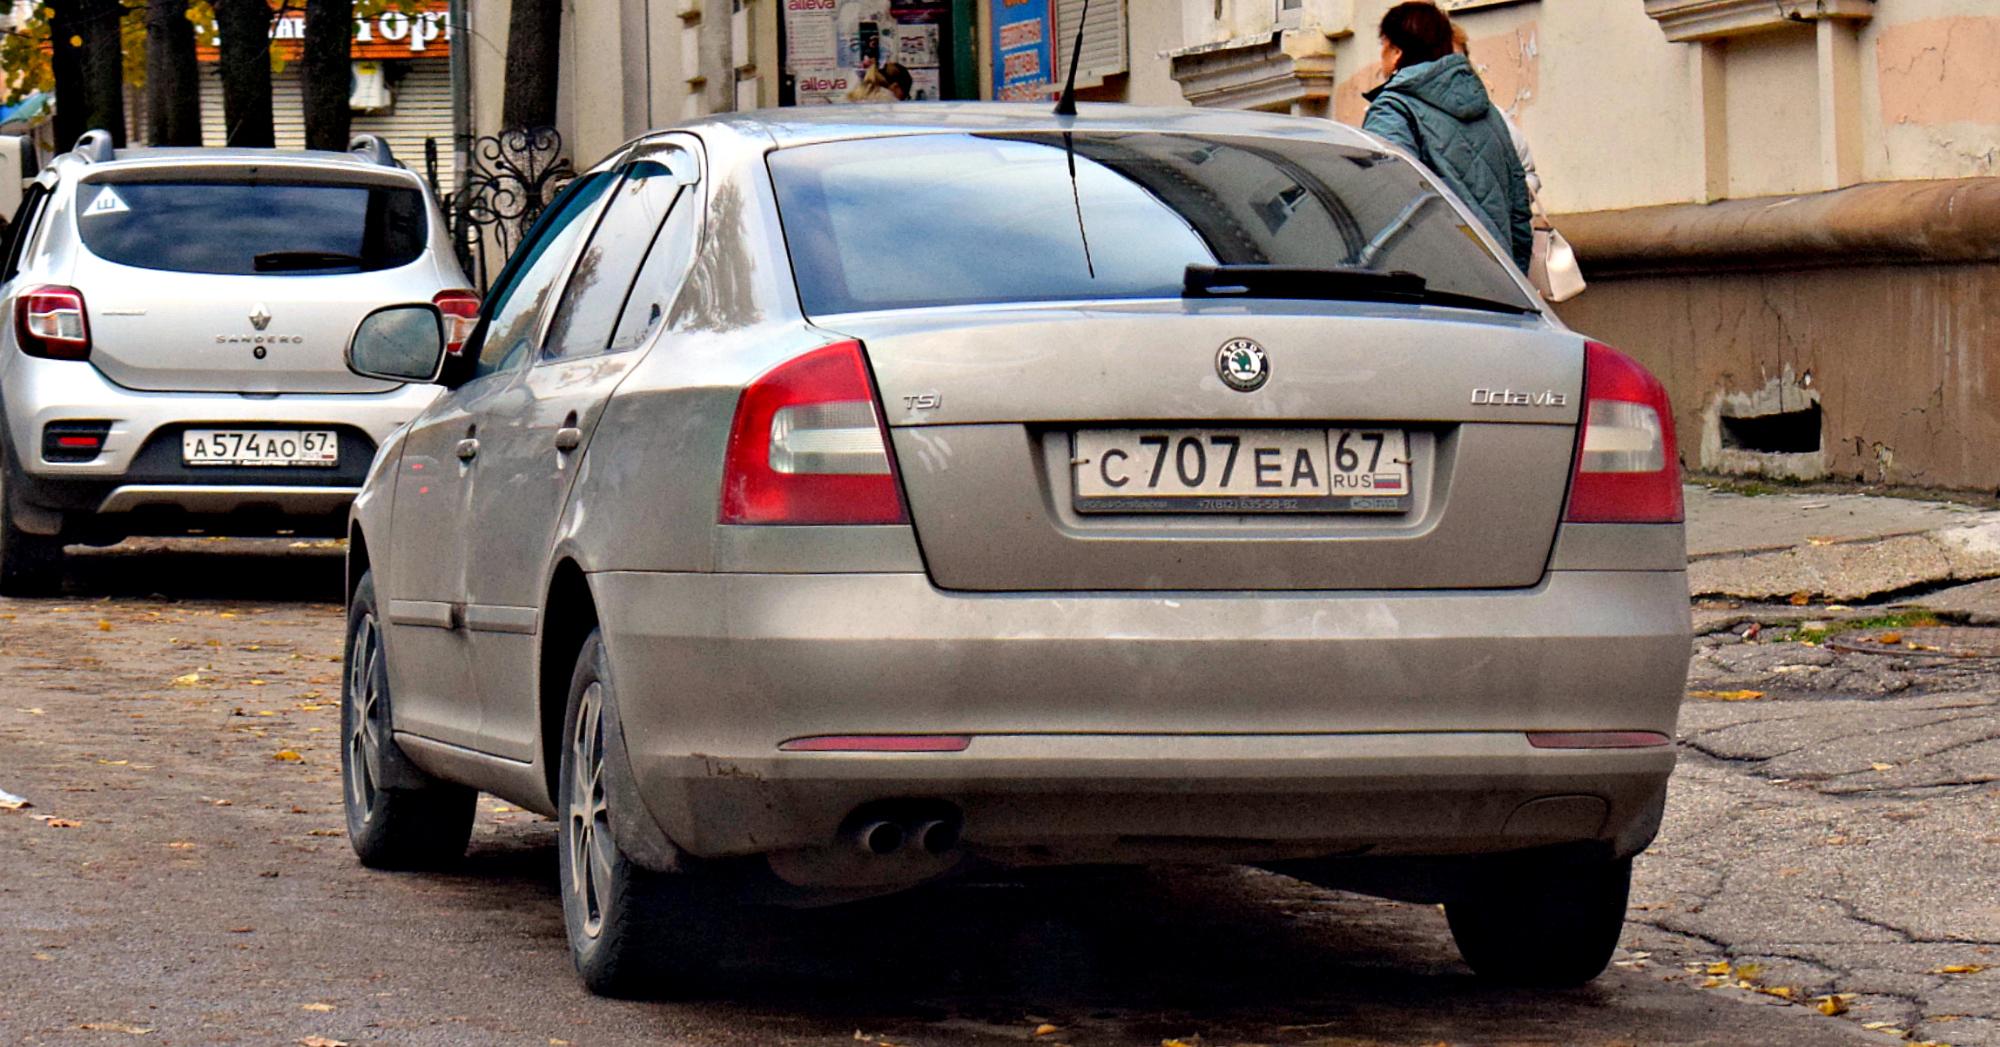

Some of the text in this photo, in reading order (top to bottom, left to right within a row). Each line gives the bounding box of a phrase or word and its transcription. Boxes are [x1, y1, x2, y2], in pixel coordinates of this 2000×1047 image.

[800, 76, 848, 91] alleva
[215, 335, 303, 344] SANDERO
[1471, 388, 1566, 407] Octavia
[304, 432, 328, 451] 67
[1335, 432, 1385, 473] 67
[1333, 474, 1372, 488] RUS
